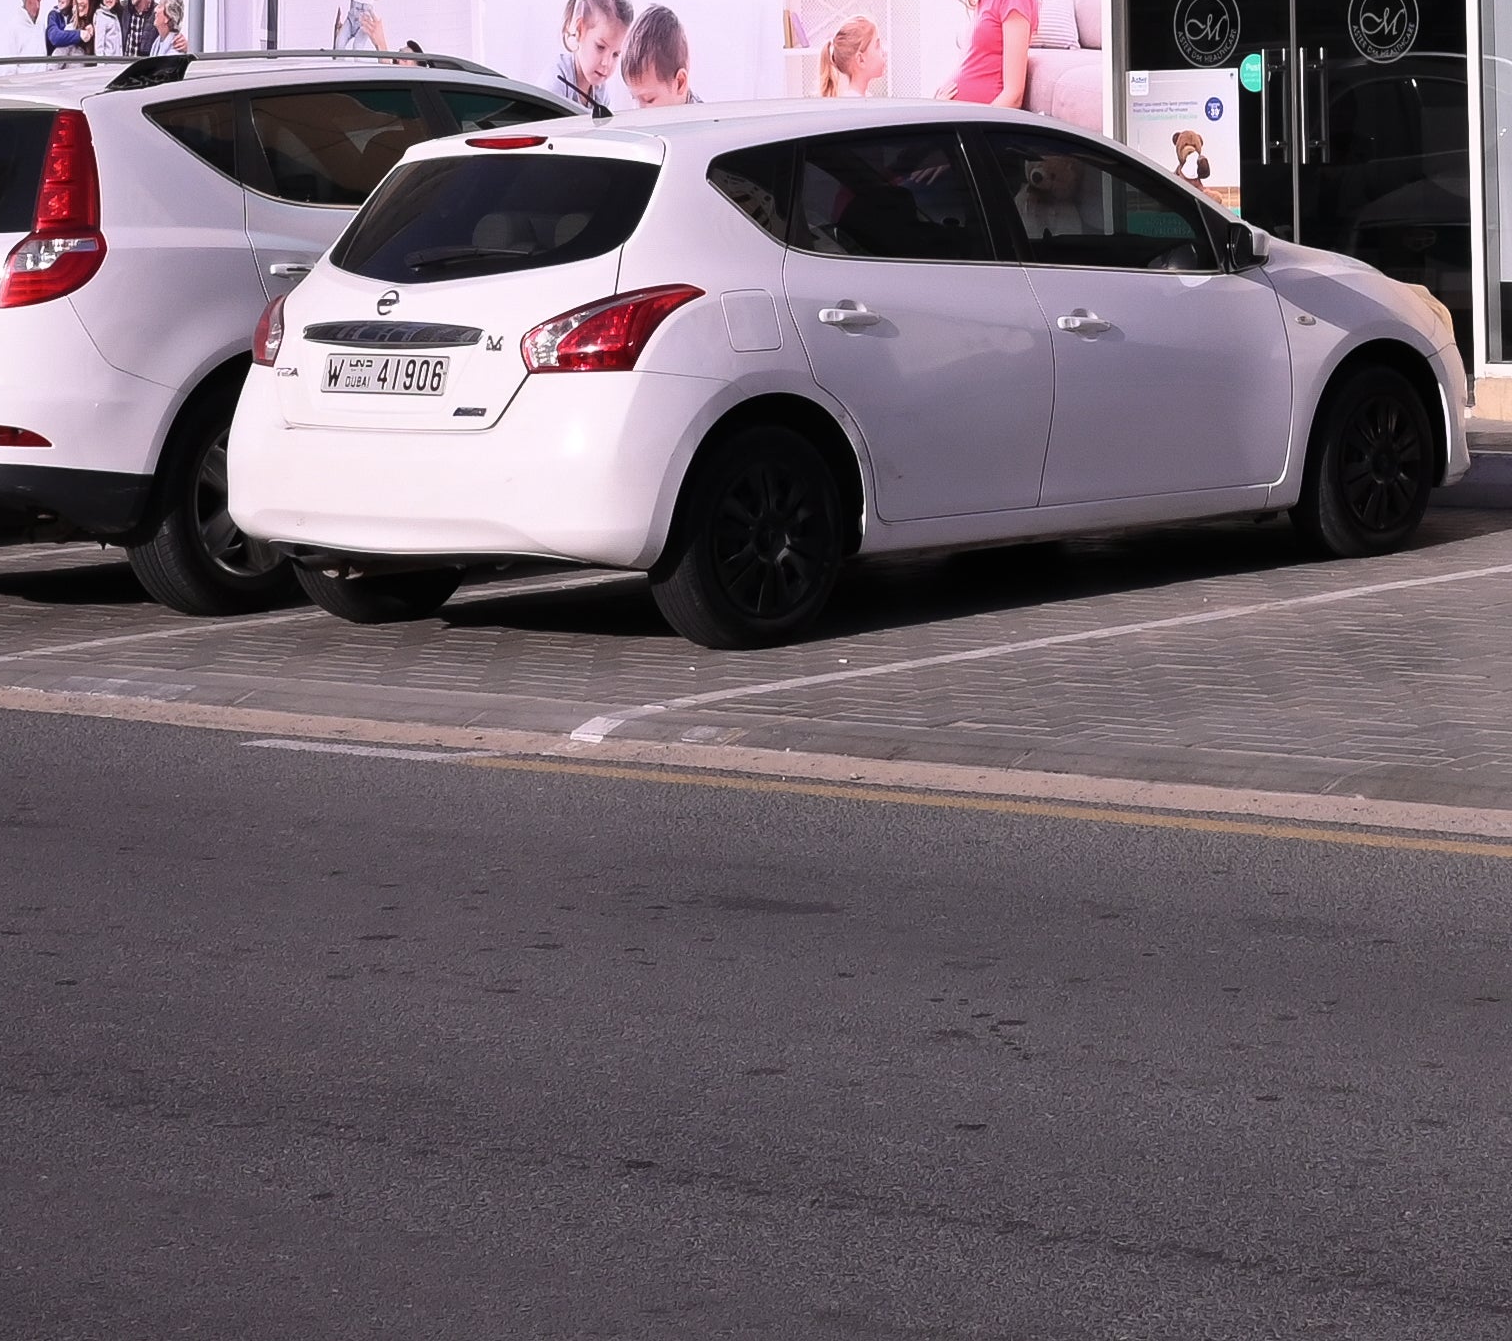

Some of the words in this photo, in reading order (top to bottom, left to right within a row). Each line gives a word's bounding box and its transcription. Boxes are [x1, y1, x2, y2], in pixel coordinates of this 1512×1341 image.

[327, 359, 344, 388] W
[345, 375, 371, 388] DUBAI
[376, 358, 445, 392] 41906
